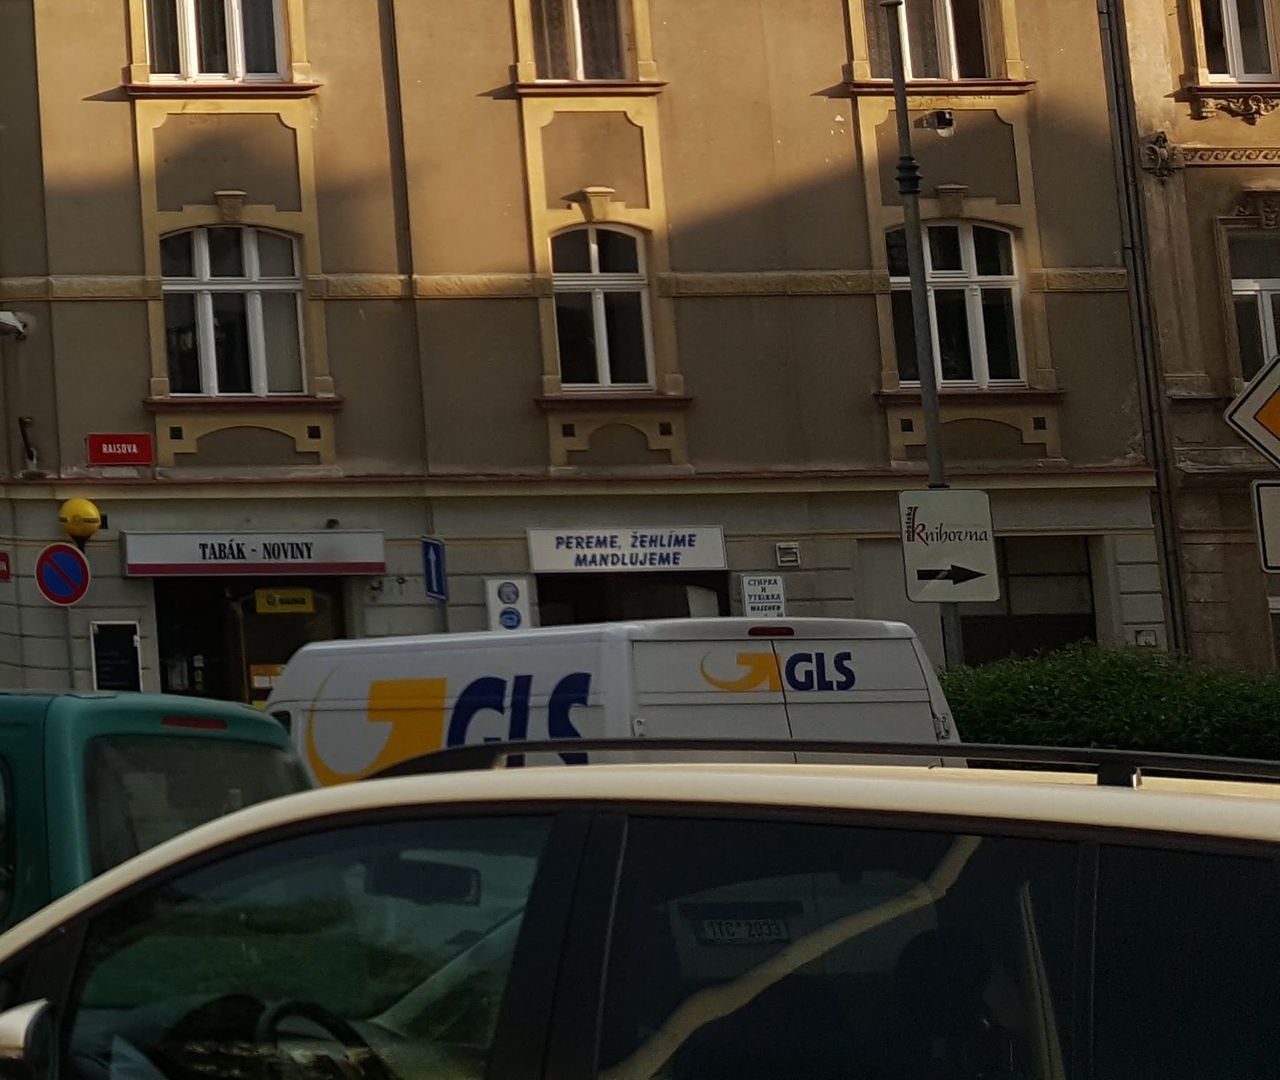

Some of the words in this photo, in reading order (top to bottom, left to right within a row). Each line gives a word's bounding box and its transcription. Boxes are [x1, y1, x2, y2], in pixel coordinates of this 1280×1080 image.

[102, 443, 139, 454] RAISOVA
[199, 539, 247, 560] TABÁK
[262, 542, 313, 560] NOVINY
[555, 535, 622, 551] PEREME,
[630, 530, 697, 549] ŽEHLÍME
[574, 552, 681, 567] MANDLUJEME
[785, 651, 856, 691] GLS
